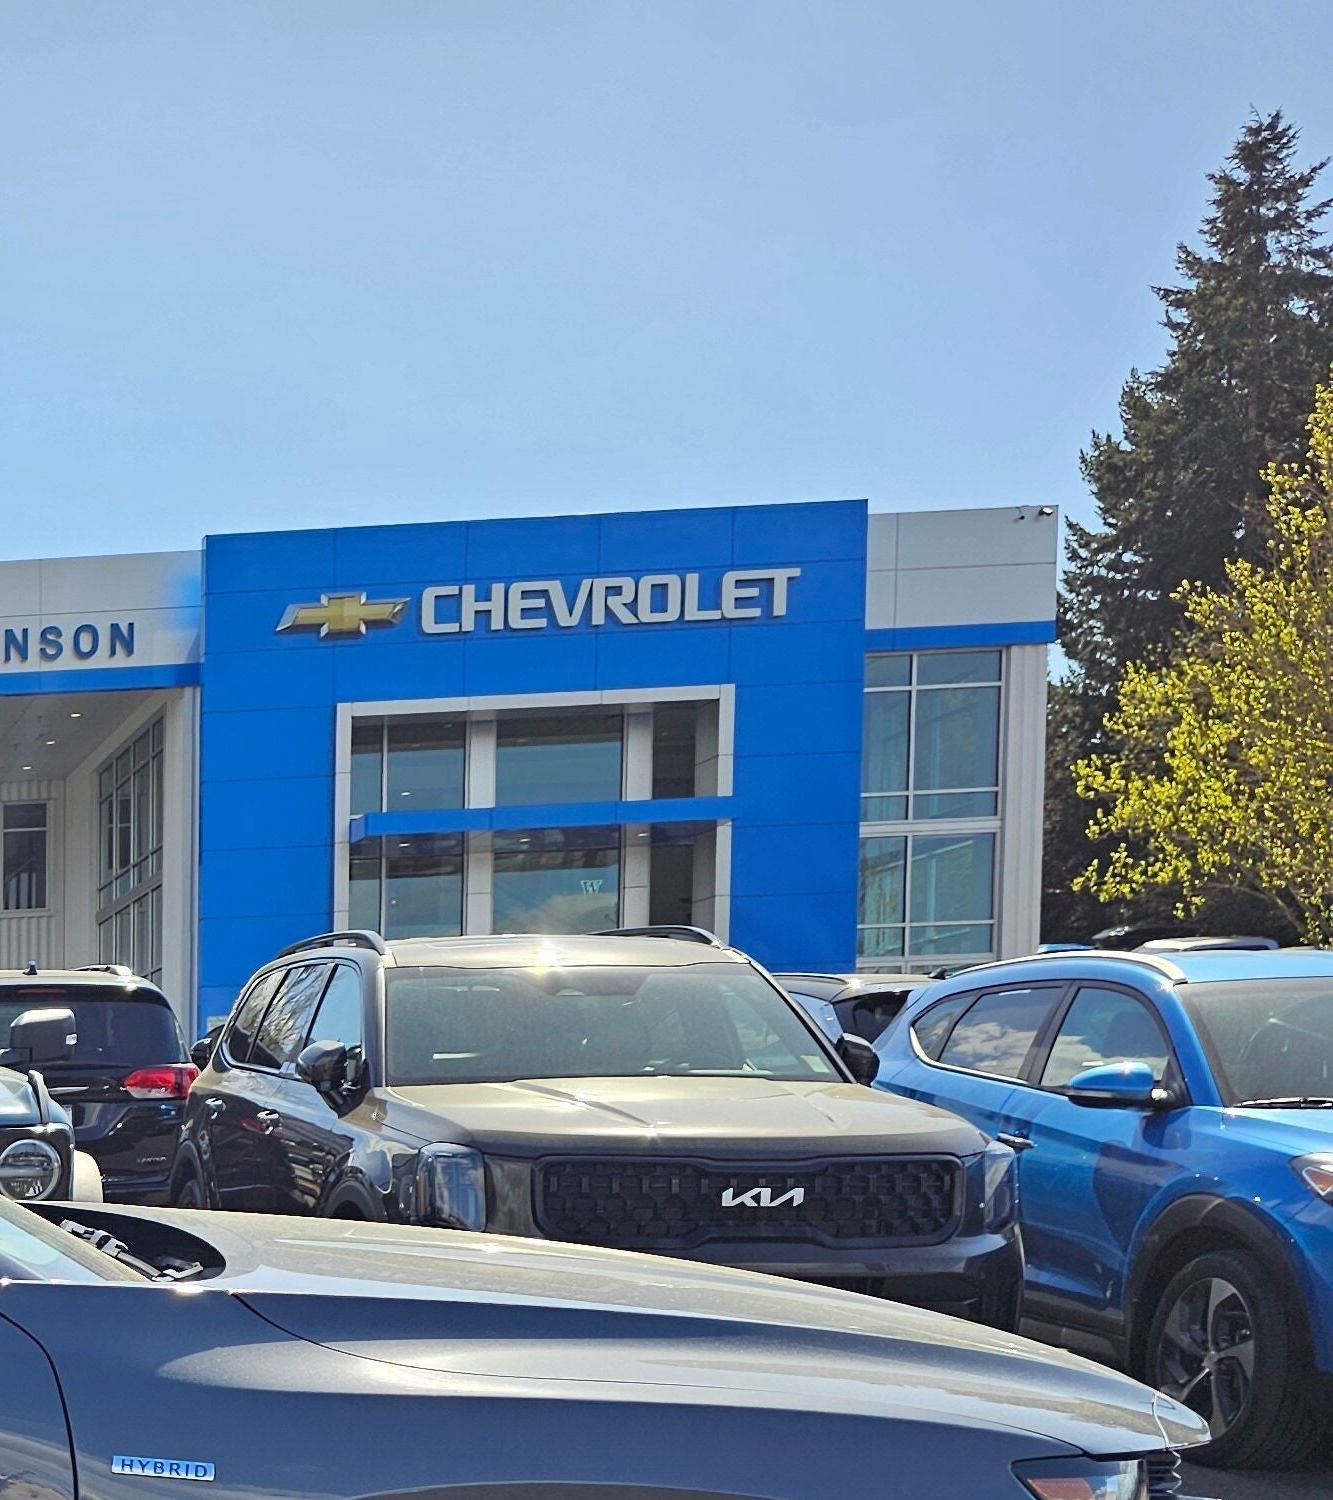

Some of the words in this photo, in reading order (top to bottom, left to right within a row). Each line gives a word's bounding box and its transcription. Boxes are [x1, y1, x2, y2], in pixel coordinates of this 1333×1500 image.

[421, 568, 801, 634] CHEVROLET
[722, 1187, 805, 1207] KIA
[121, 1458, 208, 1478] HYBRID
